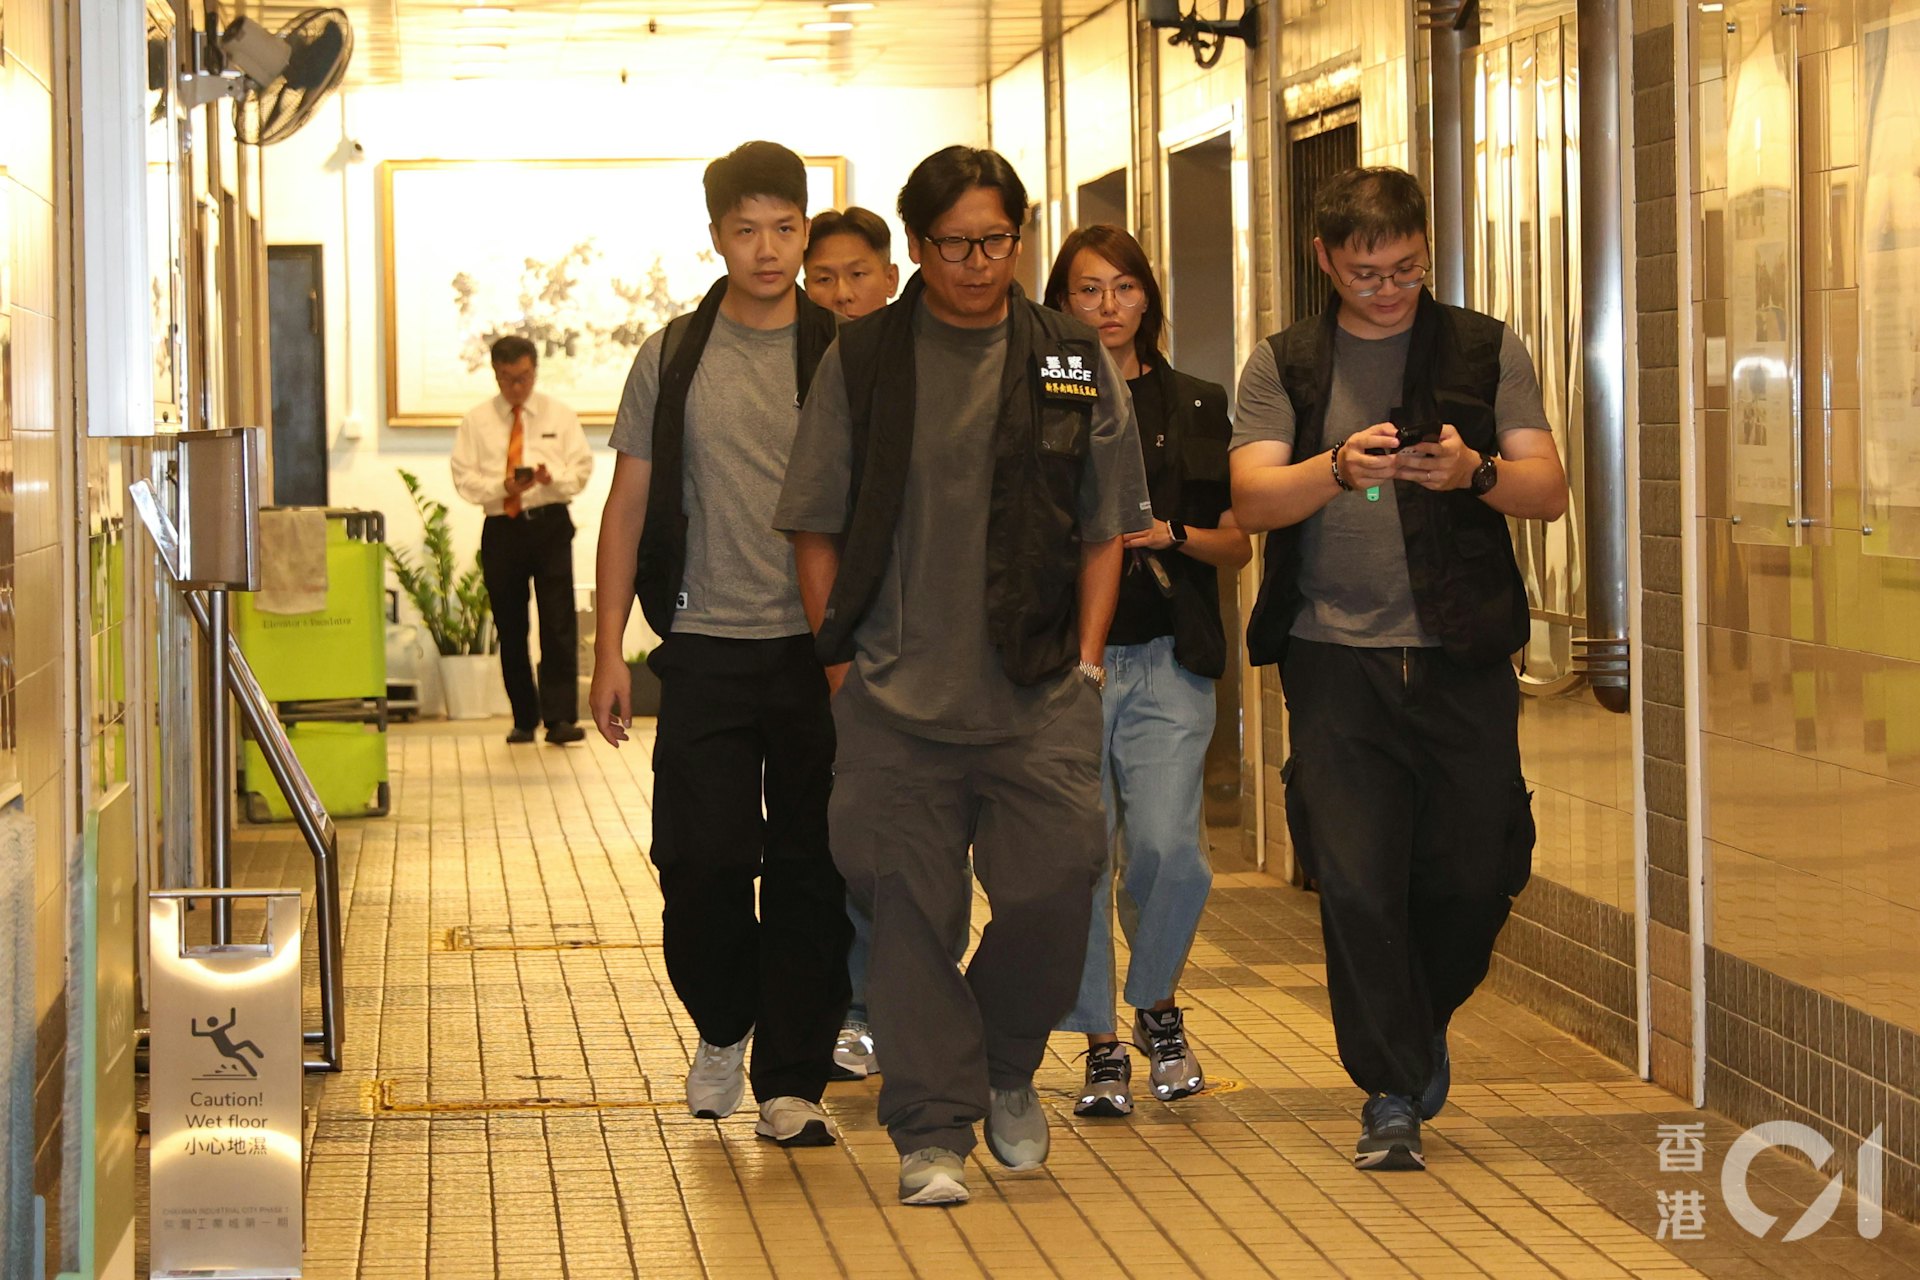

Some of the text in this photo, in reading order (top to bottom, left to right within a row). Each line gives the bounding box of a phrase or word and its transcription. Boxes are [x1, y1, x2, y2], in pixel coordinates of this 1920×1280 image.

[1040, 367, 1092, 382] POLICE
[190, 1091, 264, 1107] Caution!
[185, 1114, 268, 1129] Wet floor
[184, 1136, 267, 1156] 小心地濕
